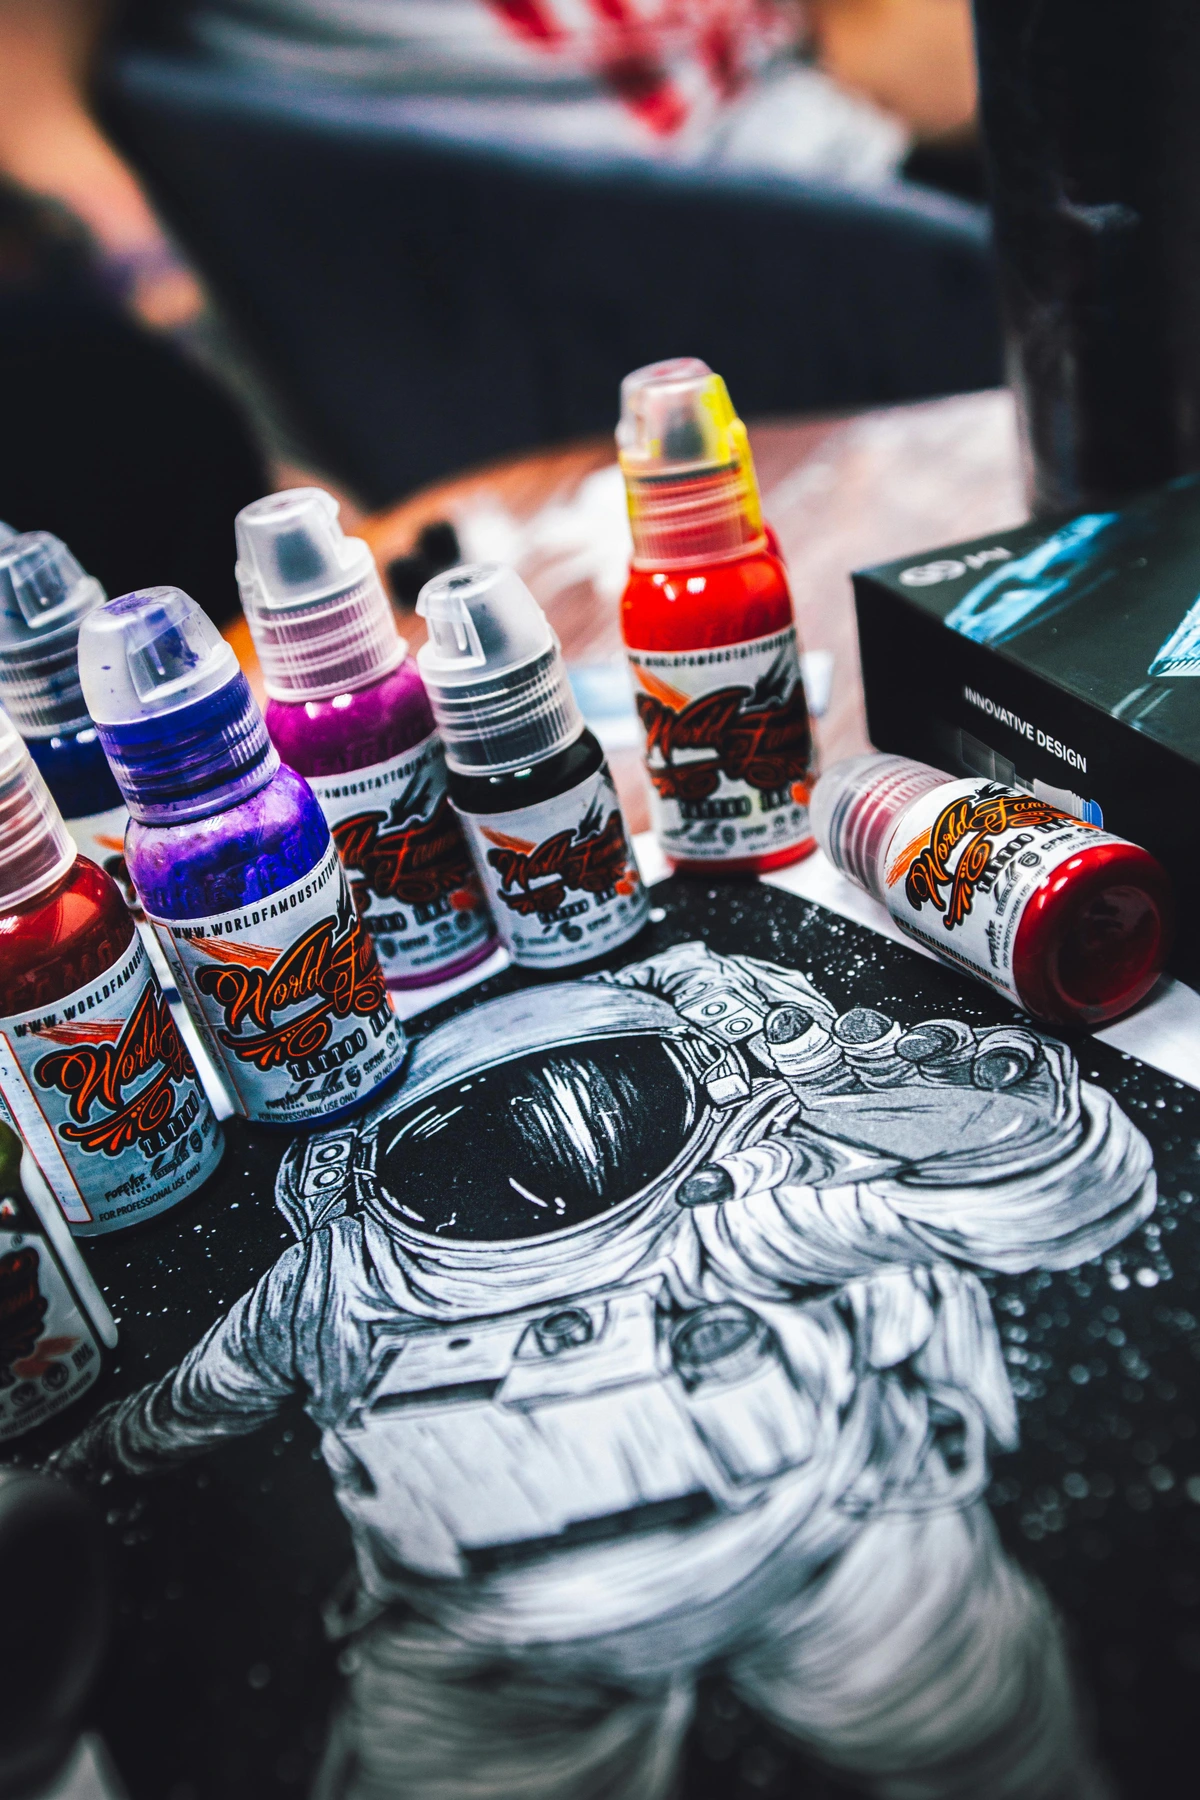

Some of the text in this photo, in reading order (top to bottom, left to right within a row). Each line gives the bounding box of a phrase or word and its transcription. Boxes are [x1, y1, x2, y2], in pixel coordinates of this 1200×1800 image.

[964, 686, 1087, 774] INNOVATIVE DESIGN
[909, 797, 971, 907] World
[979, 834, 1033, 891] TATTOO
[200, 921, 334, 1026] World
[41, 987, 159, 1118] World
[291, 1030, 364, 1079] TATTOO
[143, 1095, 198, 1154] TATTOO
[271, 1106, 323, 1121] PROFESSIONAL
[323, 1100, 339, 1112] USE
[339, 1090, 358, 1105] ONLY
[99, 1161, 201, 1222] FOR PROFESSIONAL USE ONLY
